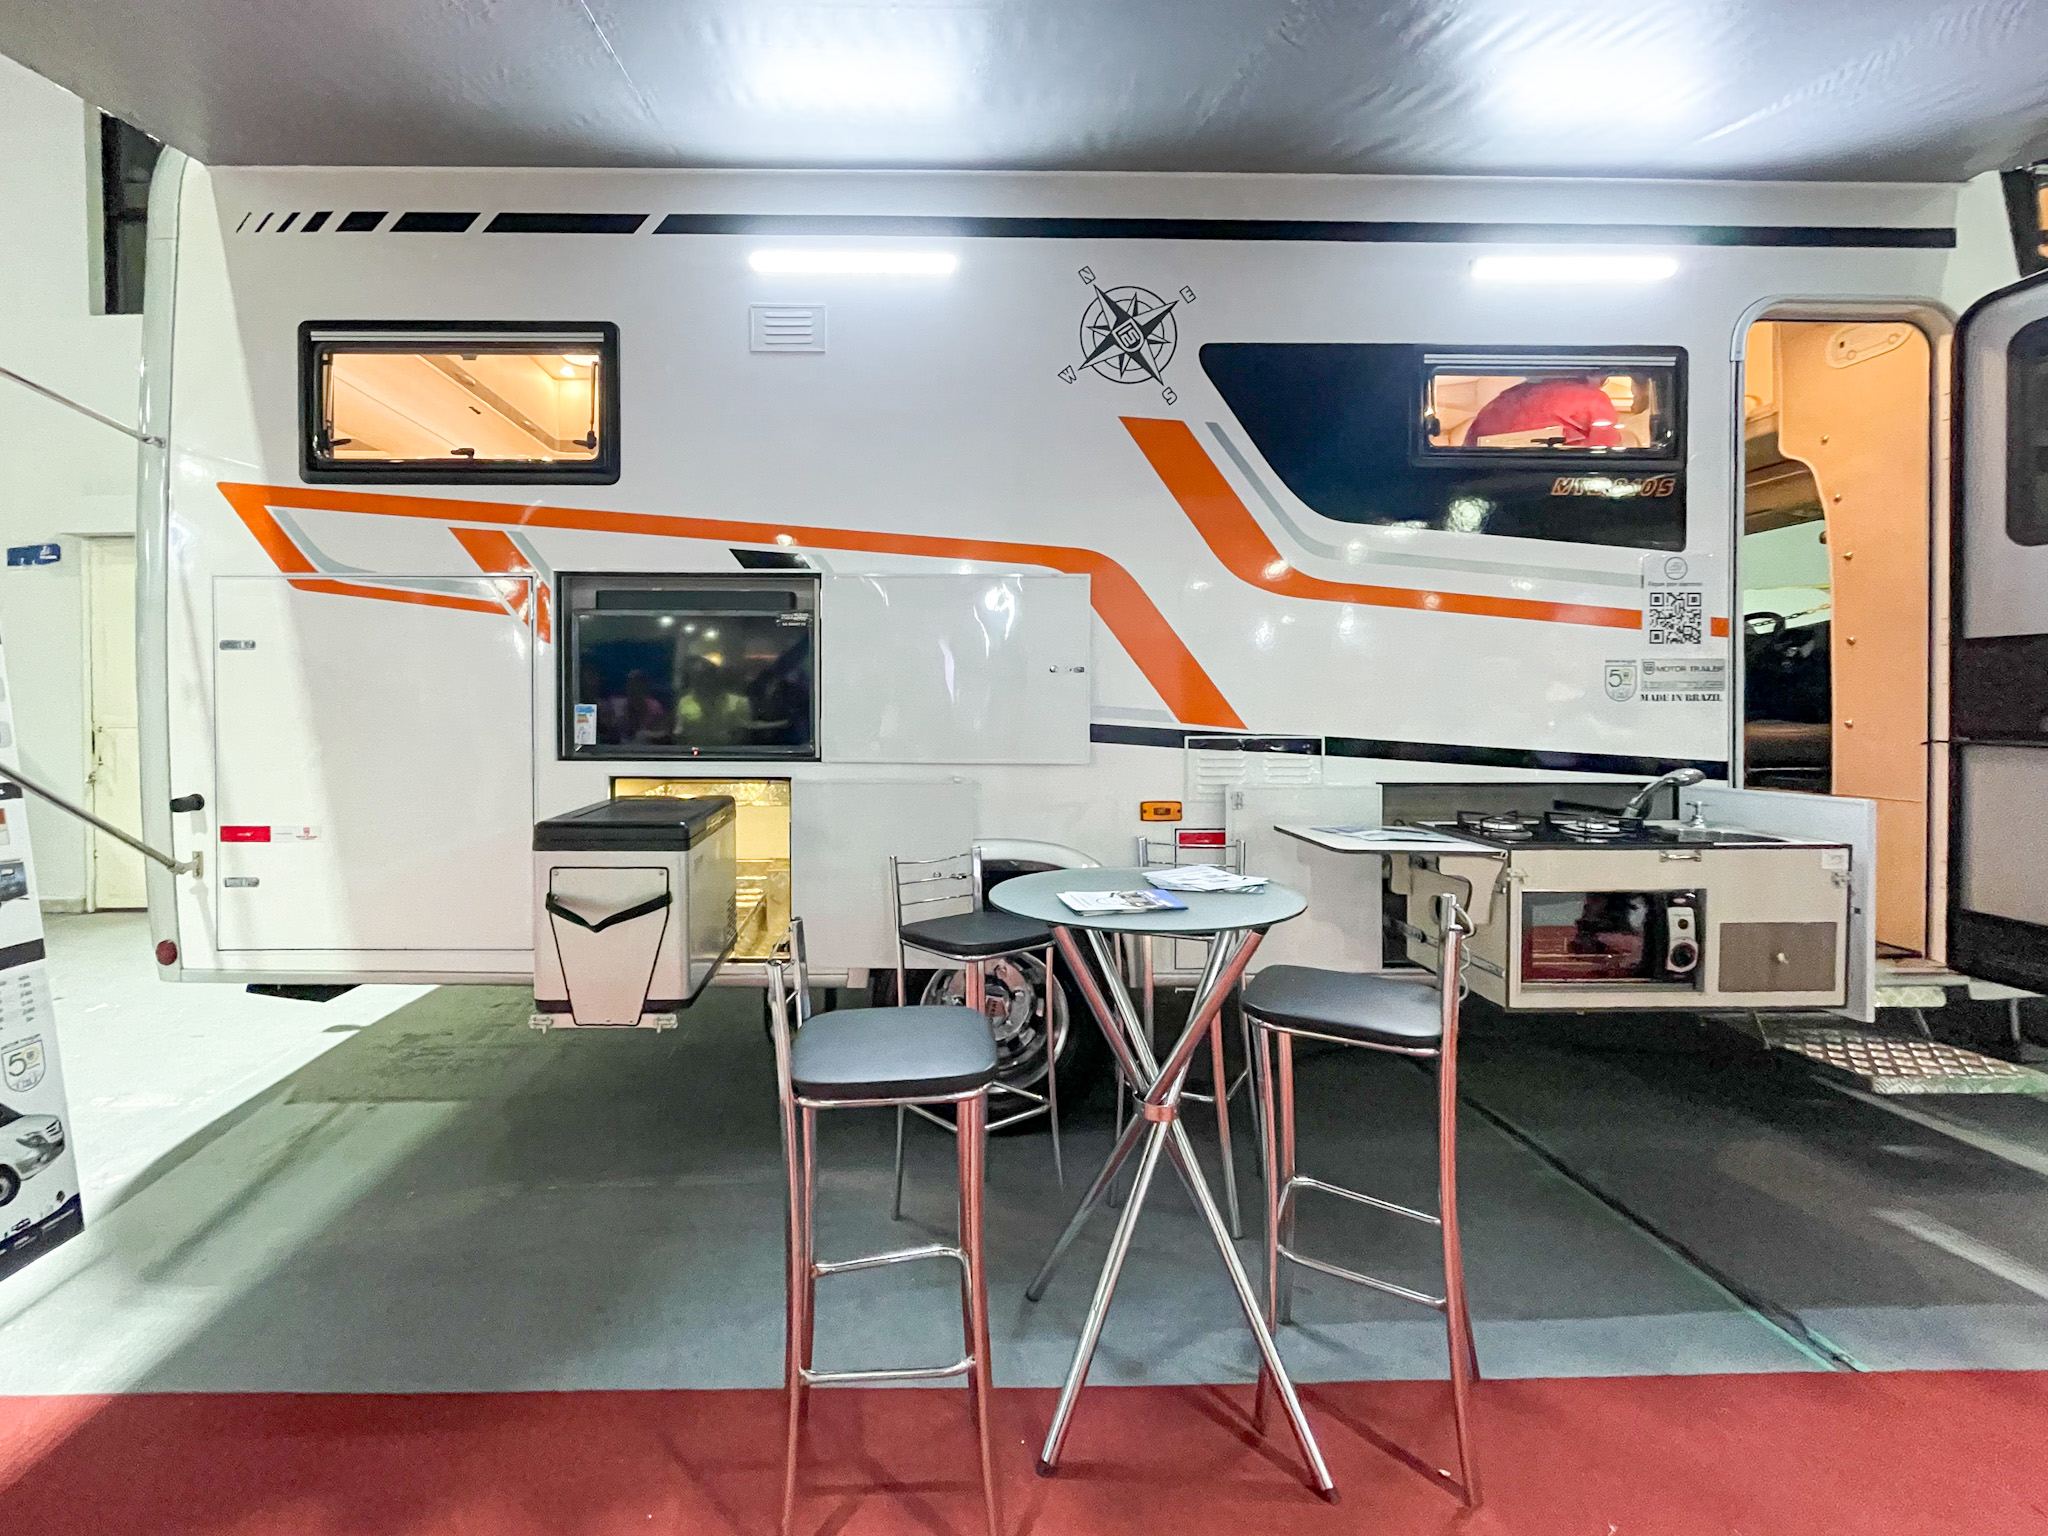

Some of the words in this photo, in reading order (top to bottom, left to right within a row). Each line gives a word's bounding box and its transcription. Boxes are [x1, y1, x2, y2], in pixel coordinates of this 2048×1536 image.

[1078, 265, 1097, 285] N
[1178, 285, 1197, 304] E
[1057, 364, 1078, 385] W
[1161, 386, 1178, 406] S
[1656, 665, 1687, 673] MOTOR
[1690, 665, 1725, 673] TRAILER
[1640, 693, 1669, 702] MADE
[1671, 693, 1683, 702] IN
[1685, 693, 1723, 702] BRAZIL
